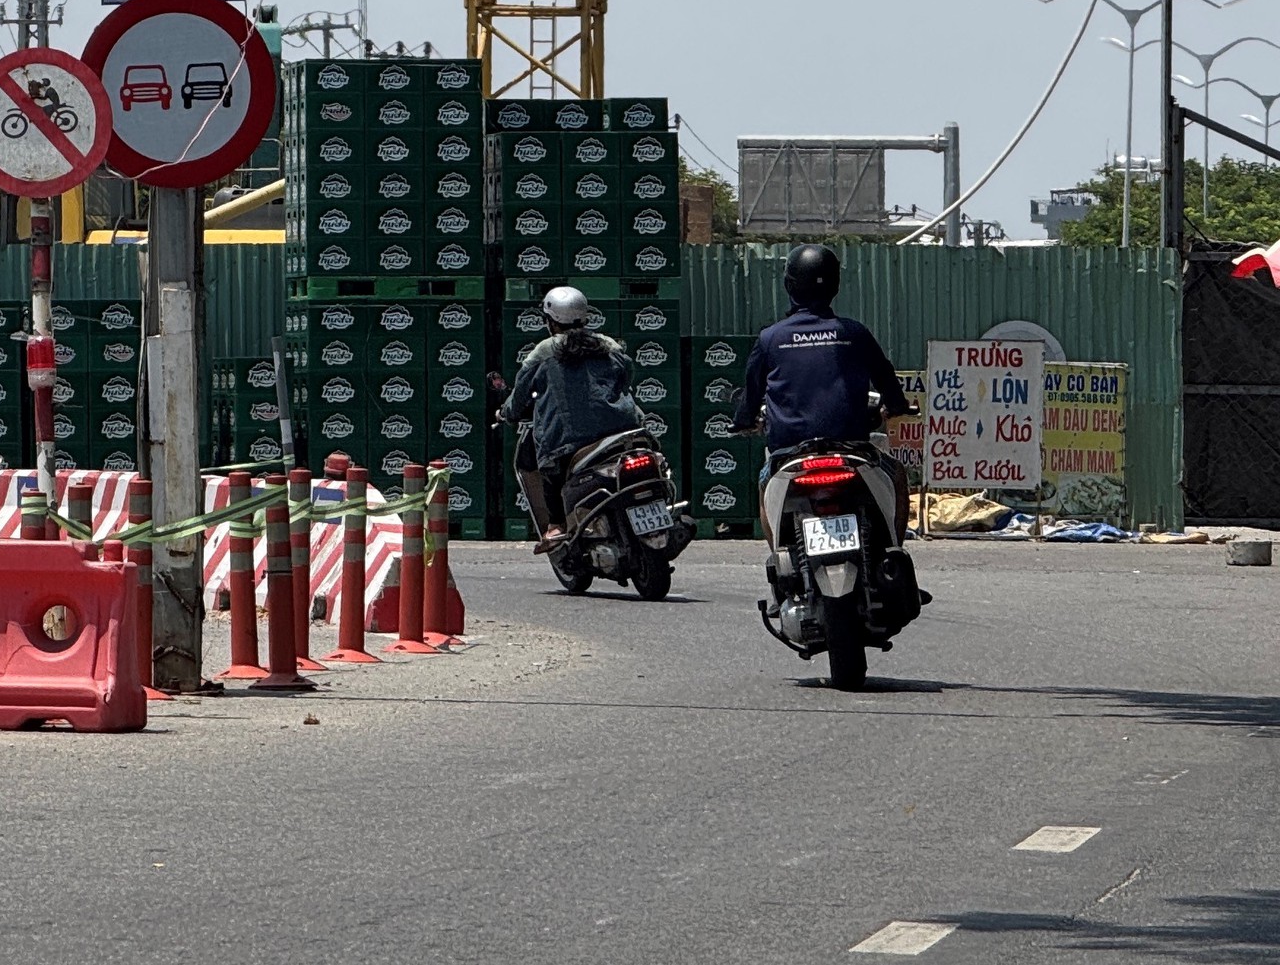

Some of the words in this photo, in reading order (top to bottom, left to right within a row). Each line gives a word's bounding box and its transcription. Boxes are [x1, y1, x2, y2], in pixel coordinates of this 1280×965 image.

[793, 330, 837, 342] DAMIAN
[955, 341, 1023, 367] TRỨNG
[992, 371, 1029, 409] LỘN
[929, 415, 967, 438] Mực
[995, 414, 1032, 442] Khô
[931, 437, 961, 458] Cá
[932, 461, 967, 481] Bia
[974, 459, 1025, 485] Rượu
